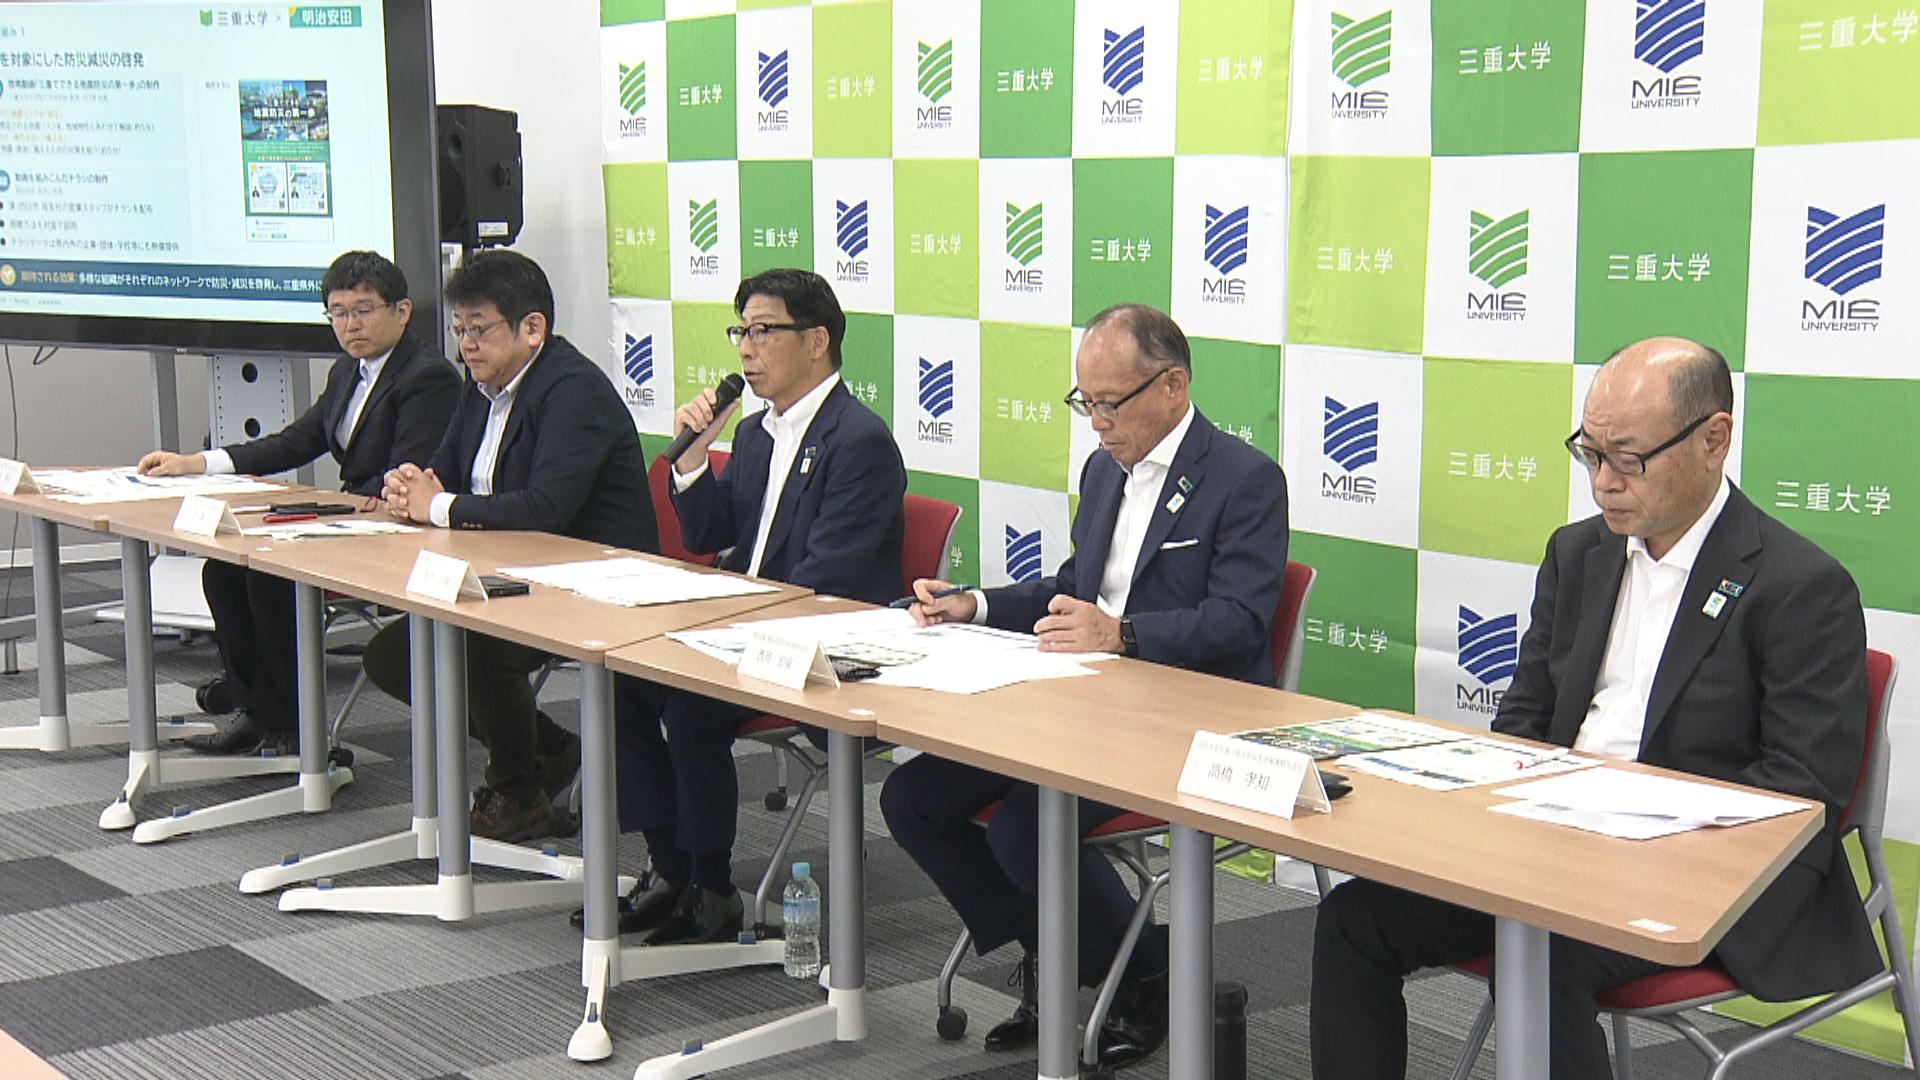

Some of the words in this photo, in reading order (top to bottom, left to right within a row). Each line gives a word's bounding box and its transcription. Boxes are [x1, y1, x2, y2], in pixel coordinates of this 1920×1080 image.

[217, 10, 268, 27] 三重大学
[302, 8, 352, 26] 明治安田
[1798, 9, 1919, 51] 三重大学
[0, 51, 145, 68] を対象にした防災減災の啓発
[1459, 41, 1552, 75] 三重大学
[1199, 55, 1264, 83] 三重大学
[827, 75, 875, 98] 三重大学
[997, 67, 1054, 93] 三重大学
[1632, 75, 1701, 98] MIE
[680, 84, 722, 106] 三重大学
[1331, 91, 1389, 109] MIE
[1631, 97, 1700, 109] UNIVERSITY
[917, 106, 952, 122] MIE
[1102, 98, 1143, 115] MIE
[1331, 109, 1388, 119] UNIVERSITY
[620, 118, 647, 132] MIE
[758, 110, 788, 125] MIE
[917, 120, 952, 130] UNIVERSITY
[1101, 115, 1142, 124] UNIVERSITY
[620, 129, 647, 138] UNIVERSITY
[758, 123, 788, 132] UNIVERSITY
[615, 227, 656, 247] 三重大学
[753, 227, 799, 249] 三重大学
[910, 233, 962, 256] 三重大学
[1090, 238, 1151, 263] 三重大学
[690, 255, 719, 270] MIE
[837, 260, 869, 276] MIE
[1317, 246, 1393, 274] 三重大学
[1607, 253, 1711, 281] 三重大学
[690, 267, 719, 276] UNIVERSITY
[837, 274, 869, 283] UNIVERSITY
[1005, 269, 1043, 285] MIE
[1005, 283, 1043, 293] UNIVERSITY
[1203, 277, 1246, 295] MIE
[1202, 294, 1245, 305] UNIVERSITY
[1467, 291, 1527, 312] MIE
[1467, 310, 1526, 321] UNIVERSITY
[1802, 299, 1880, 321] MIE
[1802, 321, 1879, 332] UNIVERSITY
[626, 387, 655, 402] MIE
[627, 399, 655, 408] UNIVERSITY
[997, 398, 1052, 423] 三重大学
[919, 420, 953, 437] MIE
[918, 435, 953, 445] UNIVERSITY
[1449, 452, 1537, 481] 三重大学
[1322, 472, 1377, 494] MIE
[1322, 489, 1376, 504] UNIVERSITY
[1775, 481, 1891, 515] 三重大学
[1306, 618, 1388, 653] 三重大学
[1457, 700, 1498, 715] UNIVER
